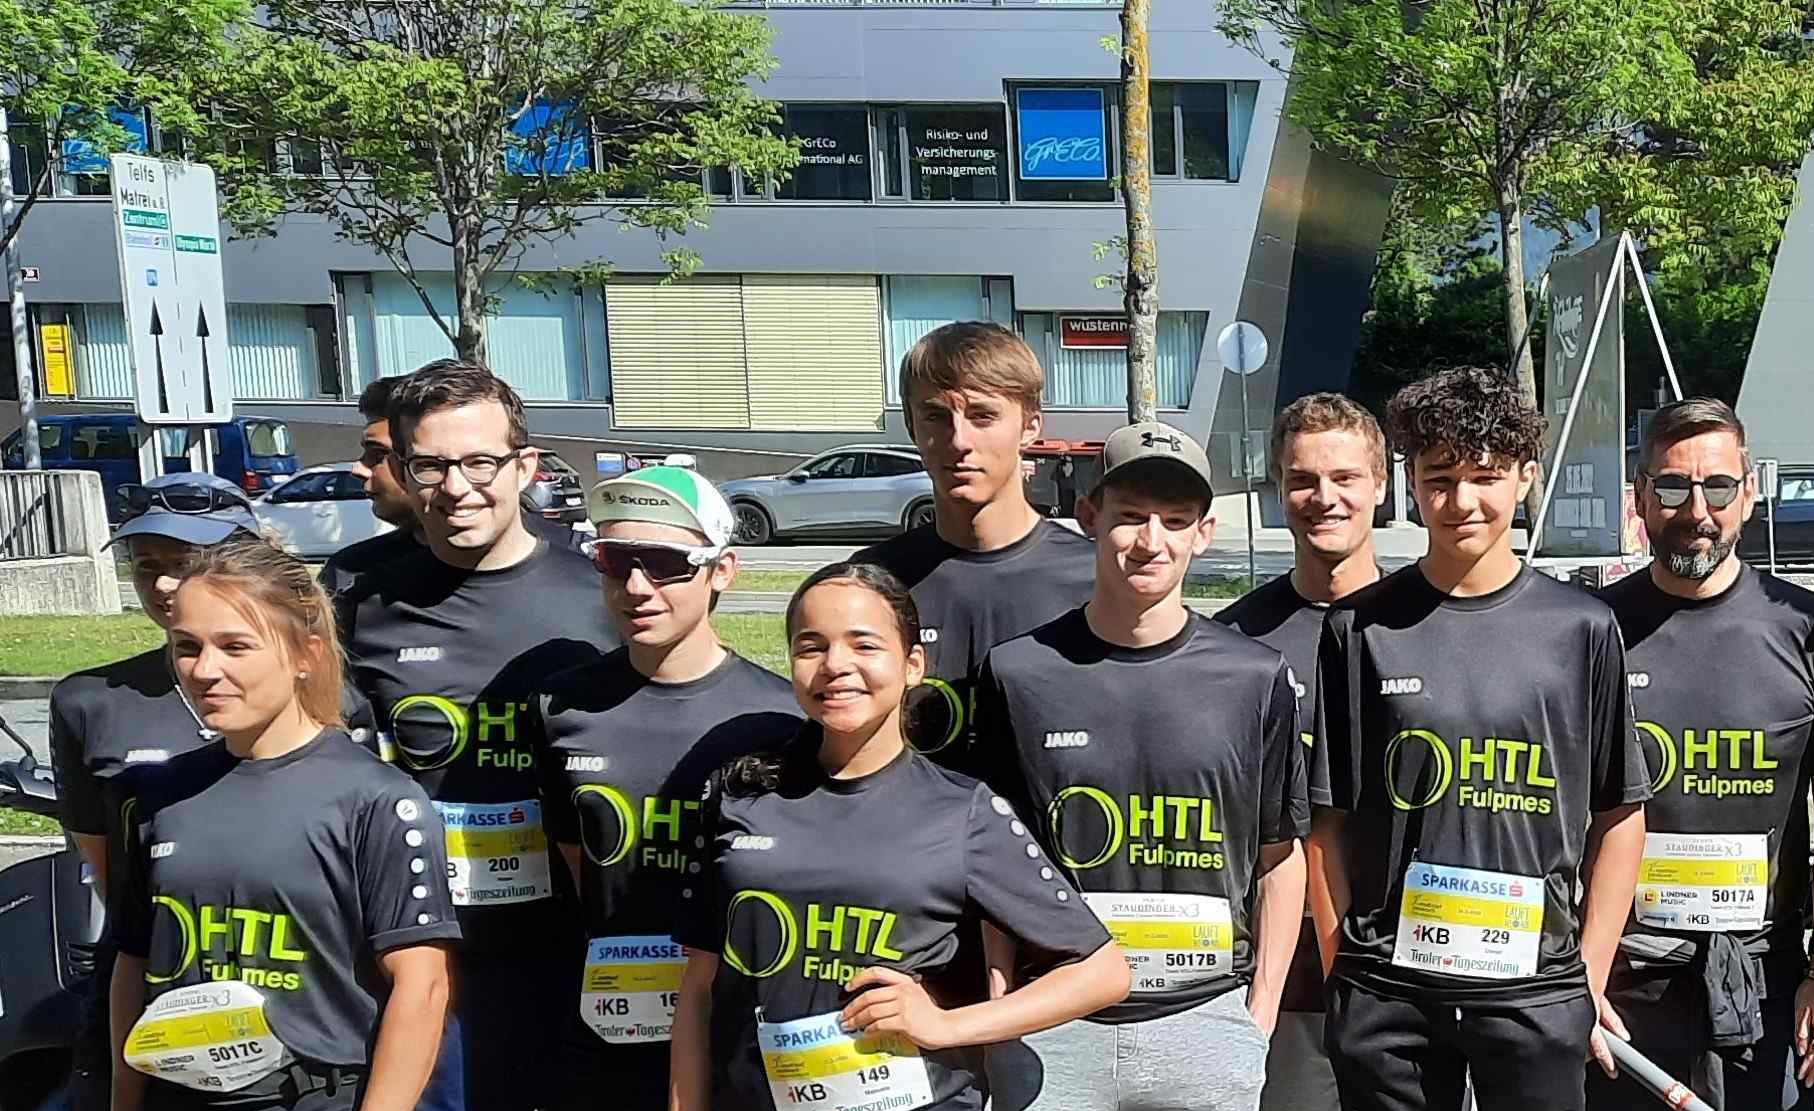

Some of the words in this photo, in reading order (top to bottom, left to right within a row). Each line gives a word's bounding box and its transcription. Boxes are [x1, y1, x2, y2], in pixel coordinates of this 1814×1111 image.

[926, 128, 962, 141] Risiko-
[966, 129, 988, 140] und
[848, 153, 864, 165] AG
[915, 146, 998, 161] Versicherungs-
[127, 162, 155, 183] Telfs
[921, 163, 998, 178] management
[1380, 678, 1423, 696] JAKO
[1044, 731, 1090, 749] JAKO
[1684, 729, 1779, 770] HTL
[477, 748, 533, 772] Fulp
[564, 756, 606, 772] JAKO
[1459, 738, 1556, 788] HTL
[1683, 774, 1774, 799] Fulpmes
[1458, 785, 1552, 815] Fulpmes
[1129, 794, 1224, 843] HTL
[487, 857, 520, 872] 200
[1129, 843, 1225, 870] Fulpmes
[1421, 872, 1507, 896] SPARKASSE
[1711, 889, 1755, 903] 5017A
[200, 905, 305, 962] HTL
[806, 903, 904, 961] HTL
[1412, 924, 1451, 945] iKB
[1481, 928, 1510, 945] 229
[598, 945, 678, 960] SPARKASSE
[1165, 952, 1217, 967] 5017B
[1410, 948, 1443, 966] Tiroler
[1452, 953, 1520, 975] Tageszeitung
[803, 955, 866, 986] Fulp
[594, 996, 630, 1016] iKB
[773, 1022, 839, 1049] SPARKA
[208, 1040, 264, 1063] 5017C
[857, 1064, 891, 1085] 149
[787, 1082, 828, 1104] iKB
